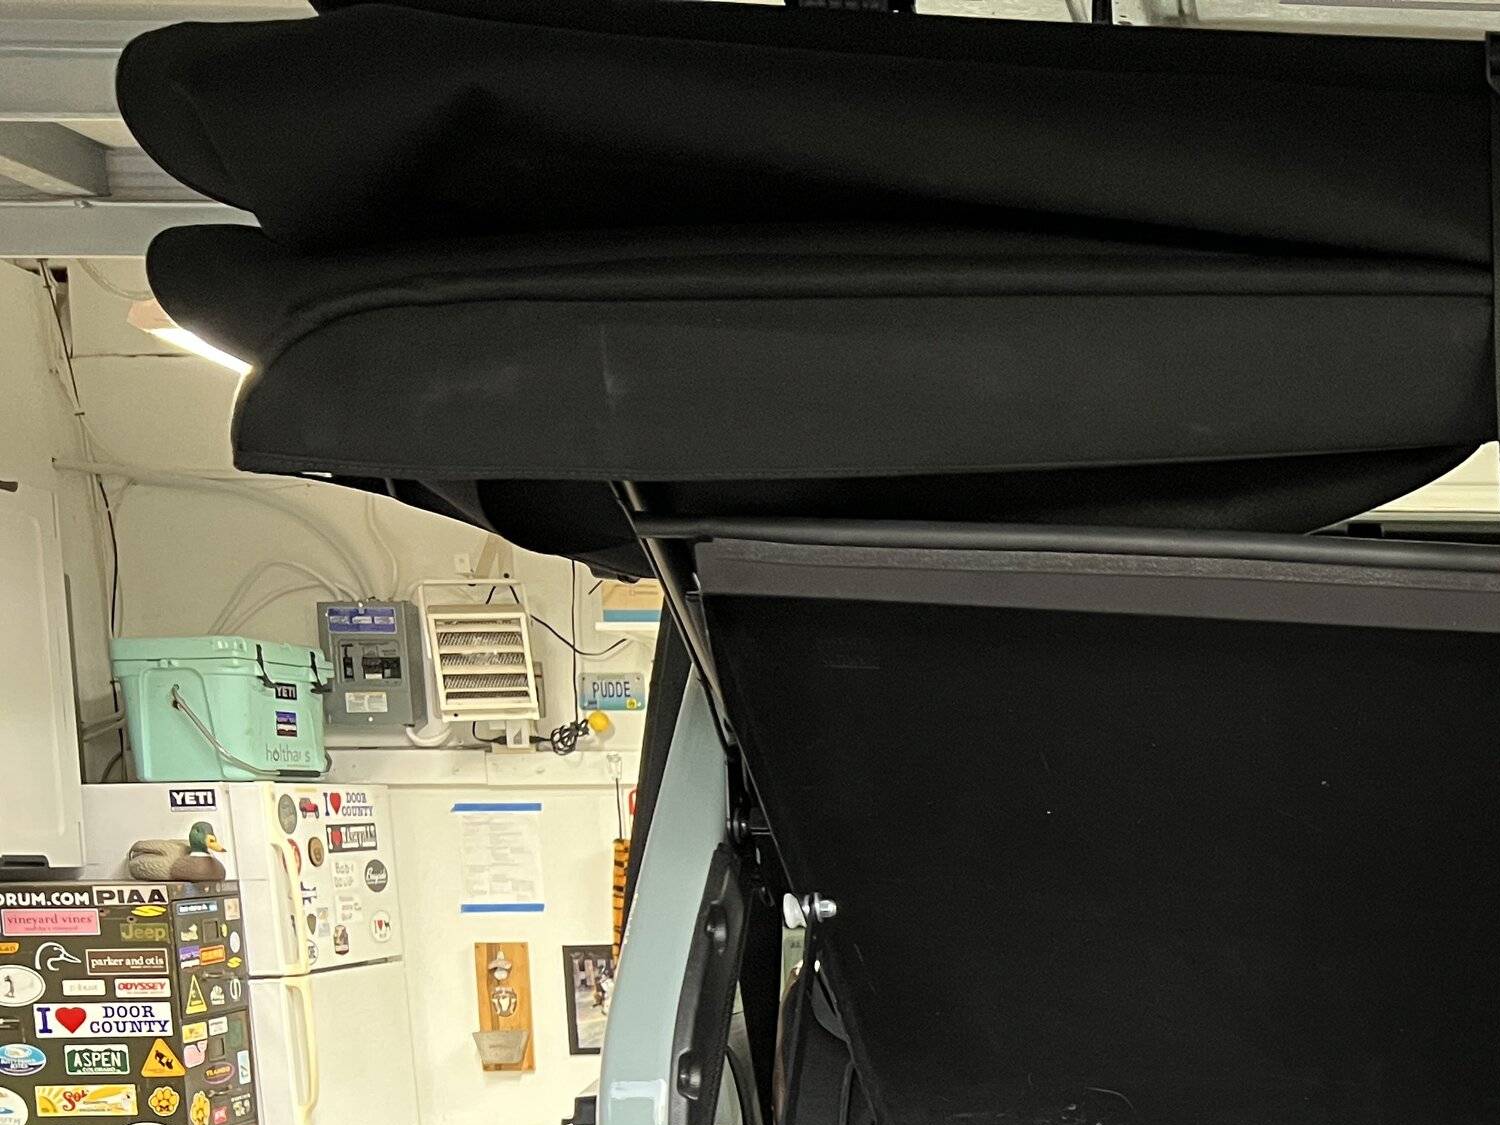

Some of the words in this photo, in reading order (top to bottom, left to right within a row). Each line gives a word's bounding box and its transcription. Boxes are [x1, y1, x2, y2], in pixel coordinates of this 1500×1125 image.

[277, 685, 296, 698] YETI
[592, 681, 631, 698] PUDDE
[171, 791, 214, 805] YETI
[323, 792, 331, 816] I
[345, 792, 368, 803] DOOR
[341, 805, 374, 817] COUNTY
[95, 889, 167, 904] PIAA
[7, 913, 58, 927] vineyard
[62, 915, 92, 924] vines
[121, 923, 167, 942] Jeep
[90, 956, 124, 969] parker
[125, 955, 144, 966] and
[145, 955, 164, 966] otis
[117, 982, 166, 991] ODYSSEY
[102, 1005, 156, 1019] DOOR
[36, 1006, 53, 1034] I
[89, 1019, 170, 1034] COUNTY
[73, 1051, 122, 1068] ASPEN
